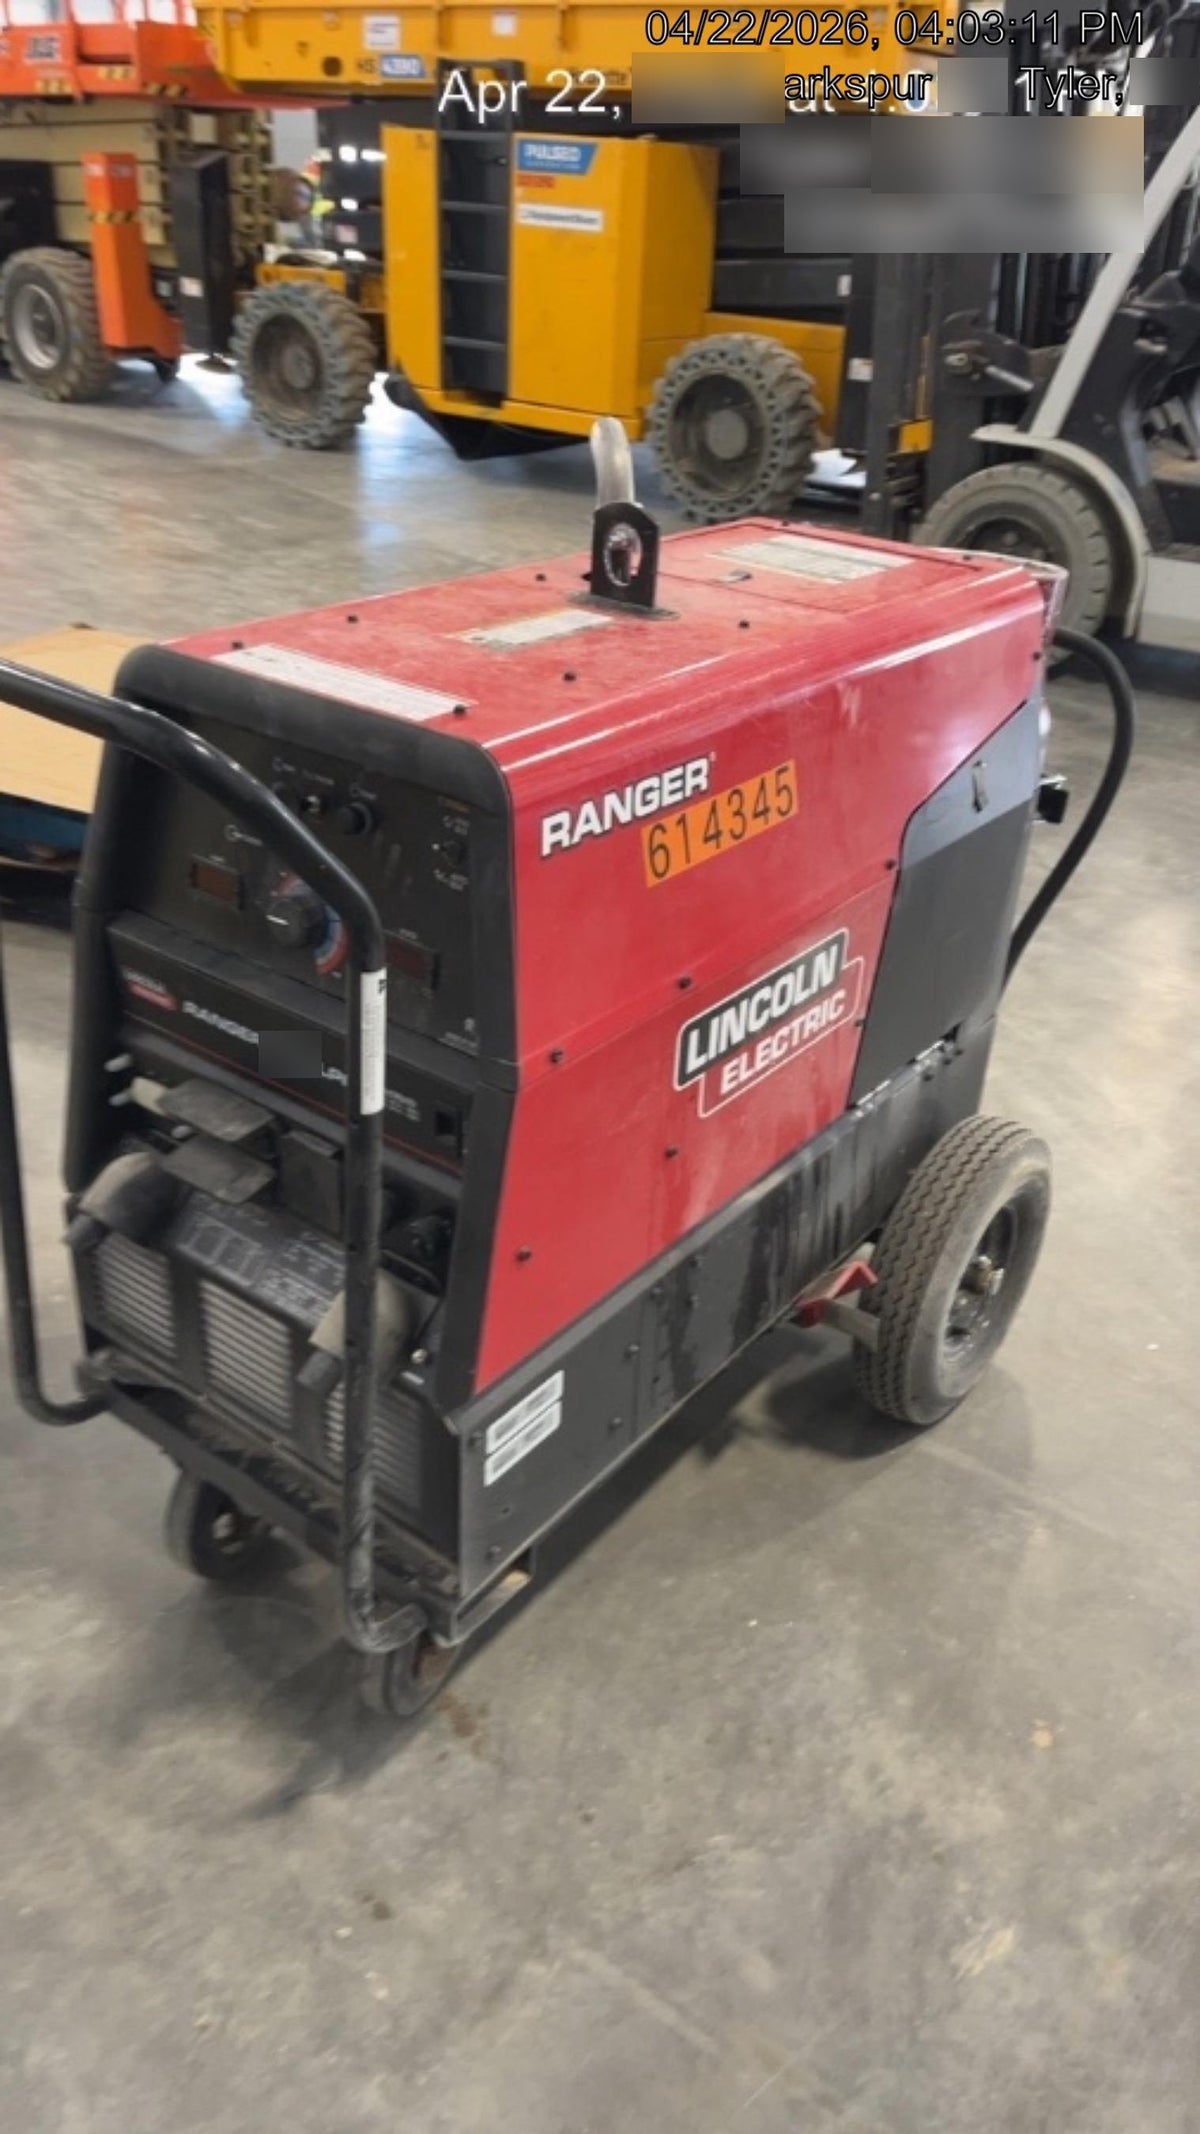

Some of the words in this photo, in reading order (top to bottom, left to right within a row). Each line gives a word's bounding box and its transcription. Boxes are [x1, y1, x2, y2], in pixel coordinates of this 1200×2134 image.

[541, 757, 712, 860] RANGER
[647, 765, 794, 880] 614345
[685, 942, 839, 1075] LINCOLN
[720, 988, 847, 1096] ELECTRIC
